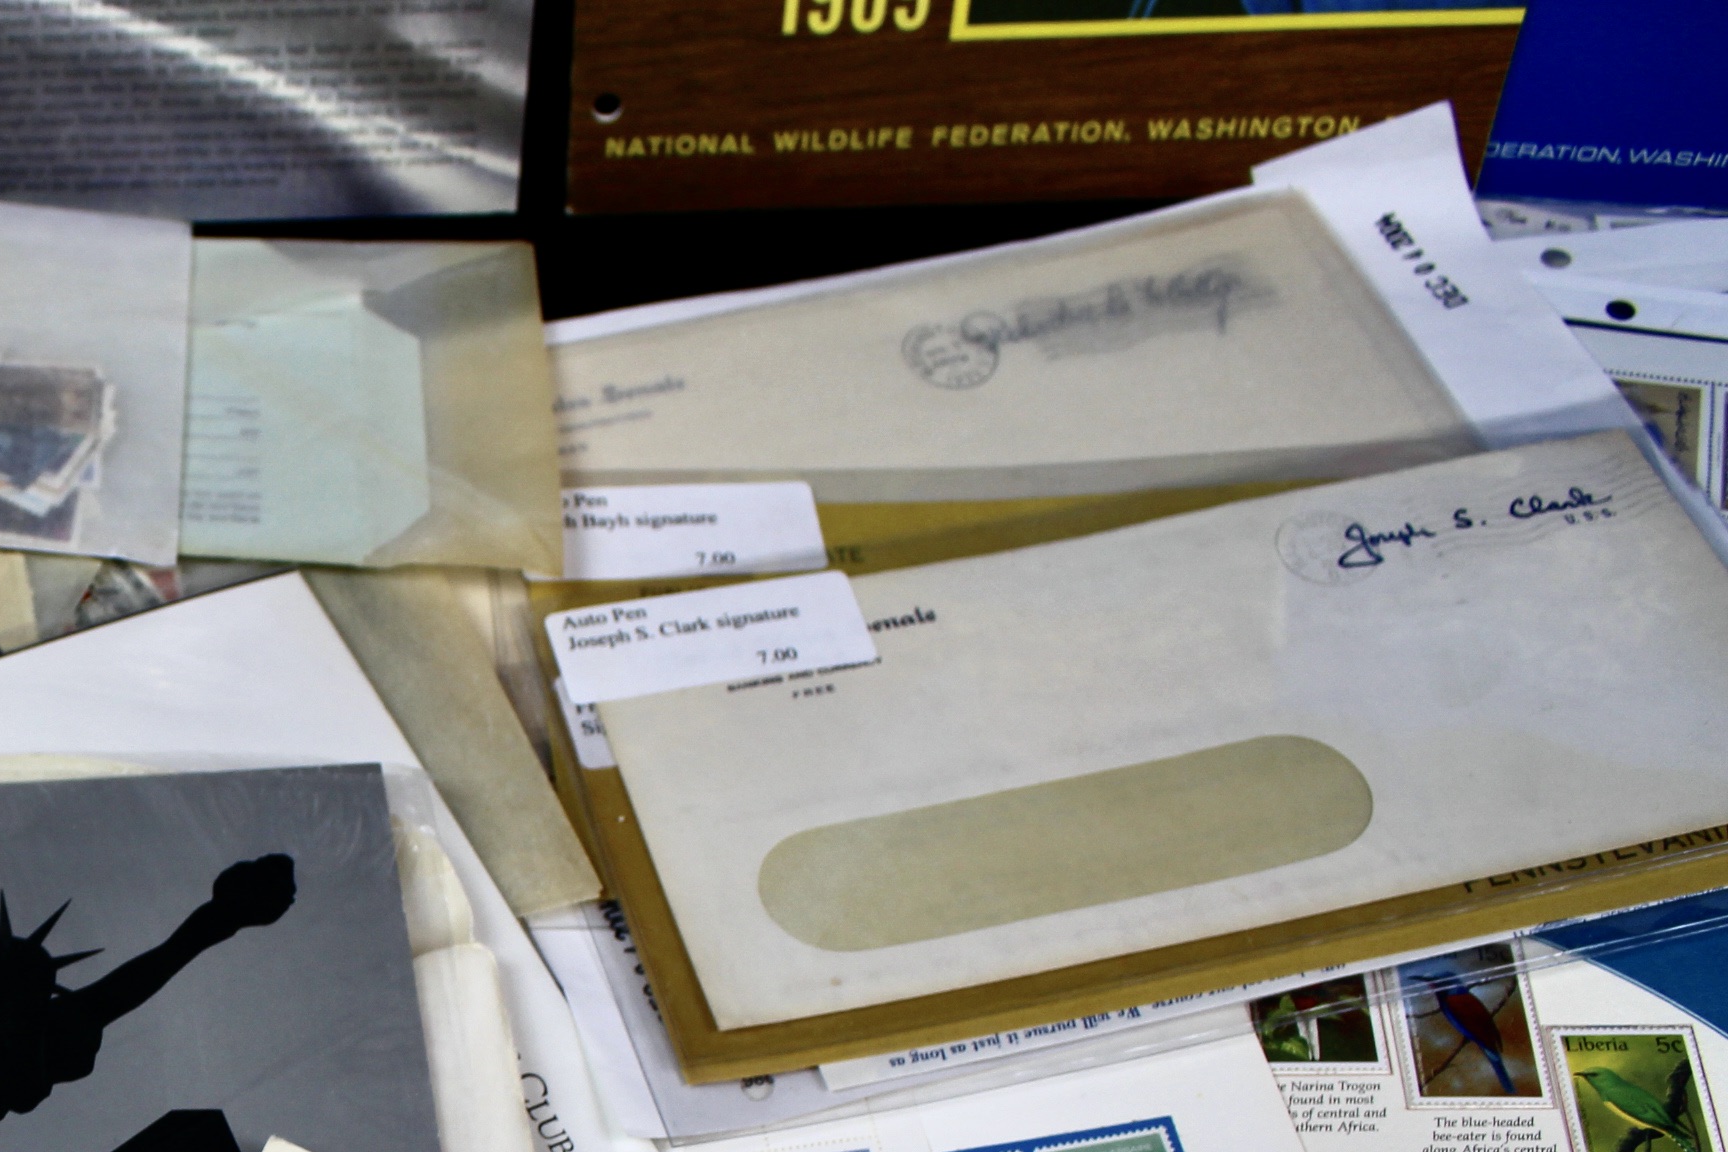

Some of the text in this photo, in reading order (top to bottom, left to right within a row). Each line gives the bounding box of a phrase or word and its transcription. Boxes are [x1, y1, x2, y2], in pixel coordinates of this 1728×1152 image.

[605, 115, 1362, 156] NATIONAL WILDLIFE FEDERATION, WASHINGTON
[1485, 140, 1728, 169] DERATION, WASHI
[562, 607, 647, 630] Auto Pen
[568, 628, 631, 650] Joseph
[657, 616, 711, 636] Clark
[715, 606, 799, 630] signature
[1024, 1019, 1078, 1038] pursue
[1081, 1011, 1113, 1030] will
[971, 1033, 1001, 1052] just
[1006, 1031, 1019, 1044] it
[1563, 1035, 1684, 1055] Liberia 5c
[909, 1047, 947, 1063] long
[949, 1043, 967, 1054] as
[888, 1056, 906, 1067] as
[1433, 1115, 1535, 1128] The blue-headed
[1431, 1129, 1542, 1144] bee-eater is found
